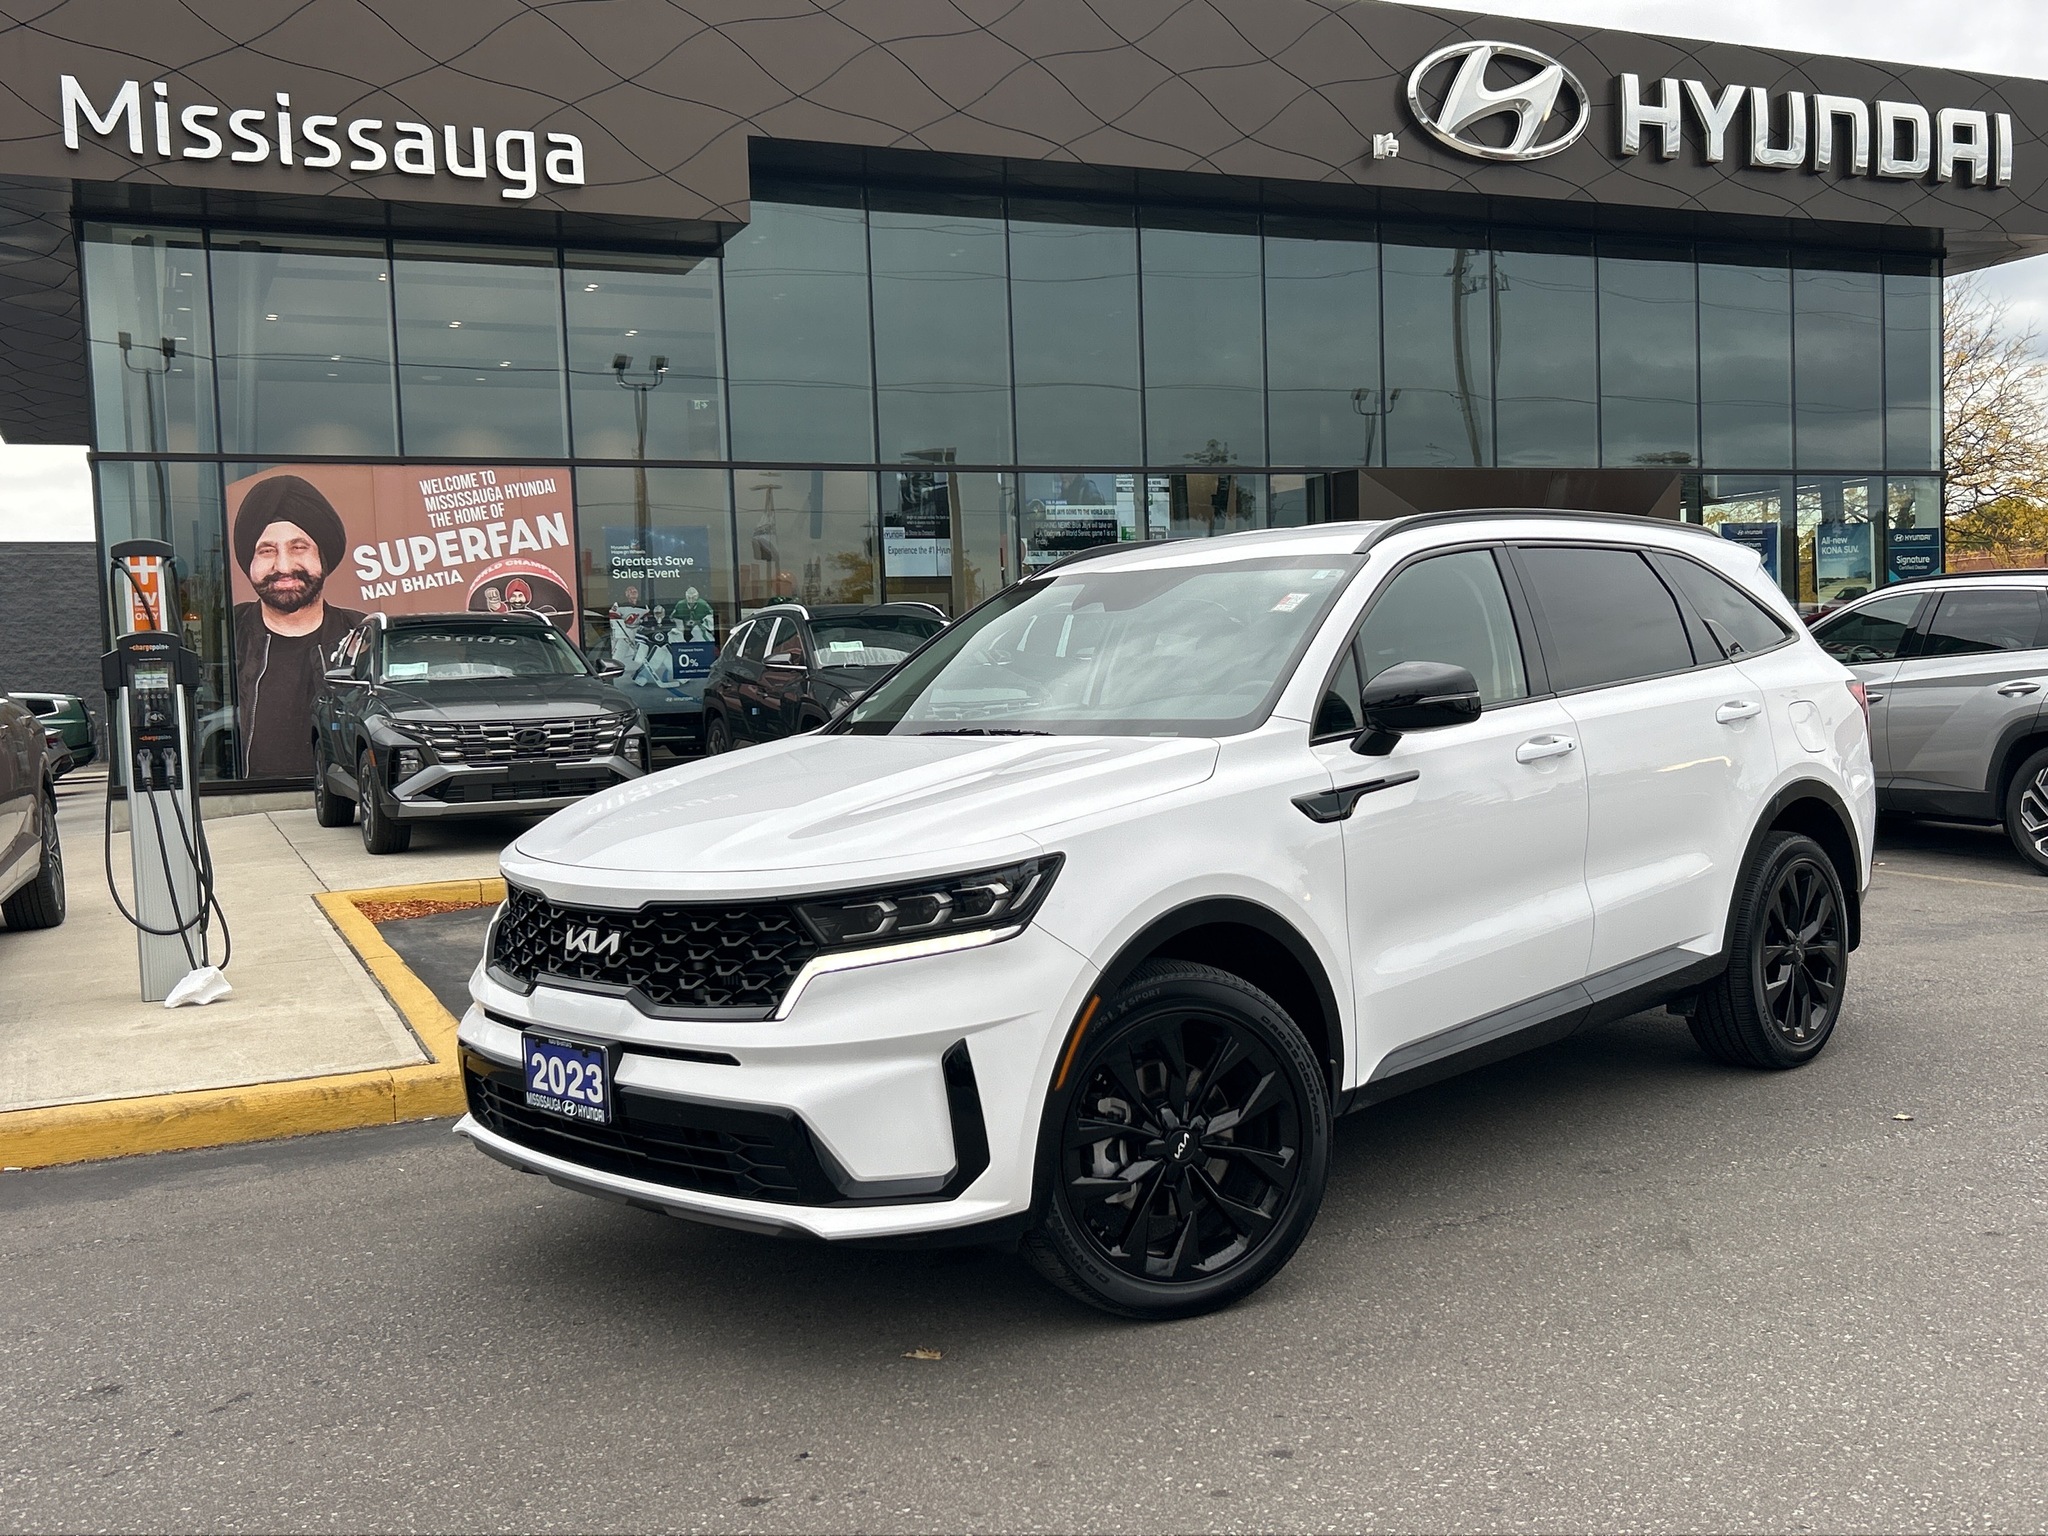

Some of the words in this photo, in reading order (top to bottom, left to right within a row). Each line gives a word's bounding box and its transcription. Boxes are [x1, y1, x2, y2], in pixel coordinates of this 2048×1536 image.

[60, 74, 586, 200] Mississauga
[1617, 72, 2013, 188] HYUNDAI
[419, 472, 479, 495] WELCOME
[480, 470, 496, 485] TO
[424, 486, 504, 512] MISSISSAUGA
[504, 478, 556, 499] HYUNDAI
[428, 511, 453, 528] THE
[454, 505, 489, 524] HOME
[490, 503, 505, 519] OF
[352, 512, 570, 582] SUPERFAN
[1821, 536, 1848, 545] All-new
[1904, 533, 1932, 541] HYUNDAI
[612, 556, 663, 567] Greatest
[665, 555, 694, 566] Save
[888, 546, 917, 555] Experience
[919, 546, 928, 554] the
[1821, 547, 1842, 555] KONA
[1896, 555, 1931, 565] Signature
[360, 577, 396, 601] NAV
[402, 569, 464, 593] BHATIA
[612, 569, 645, 579] Sales
[647, 568, 680, 578] Event
[135, 613, 159, 621] ONY
[679, 654, 699, 667] 0%
[565, 927, 621, 956] KIA
[531, 1052, 604, 1104] 2023
[526, 1091, 562, 1113] MISSISSAUGA
[577, 1104, 605, 1123] HYUNDAI
